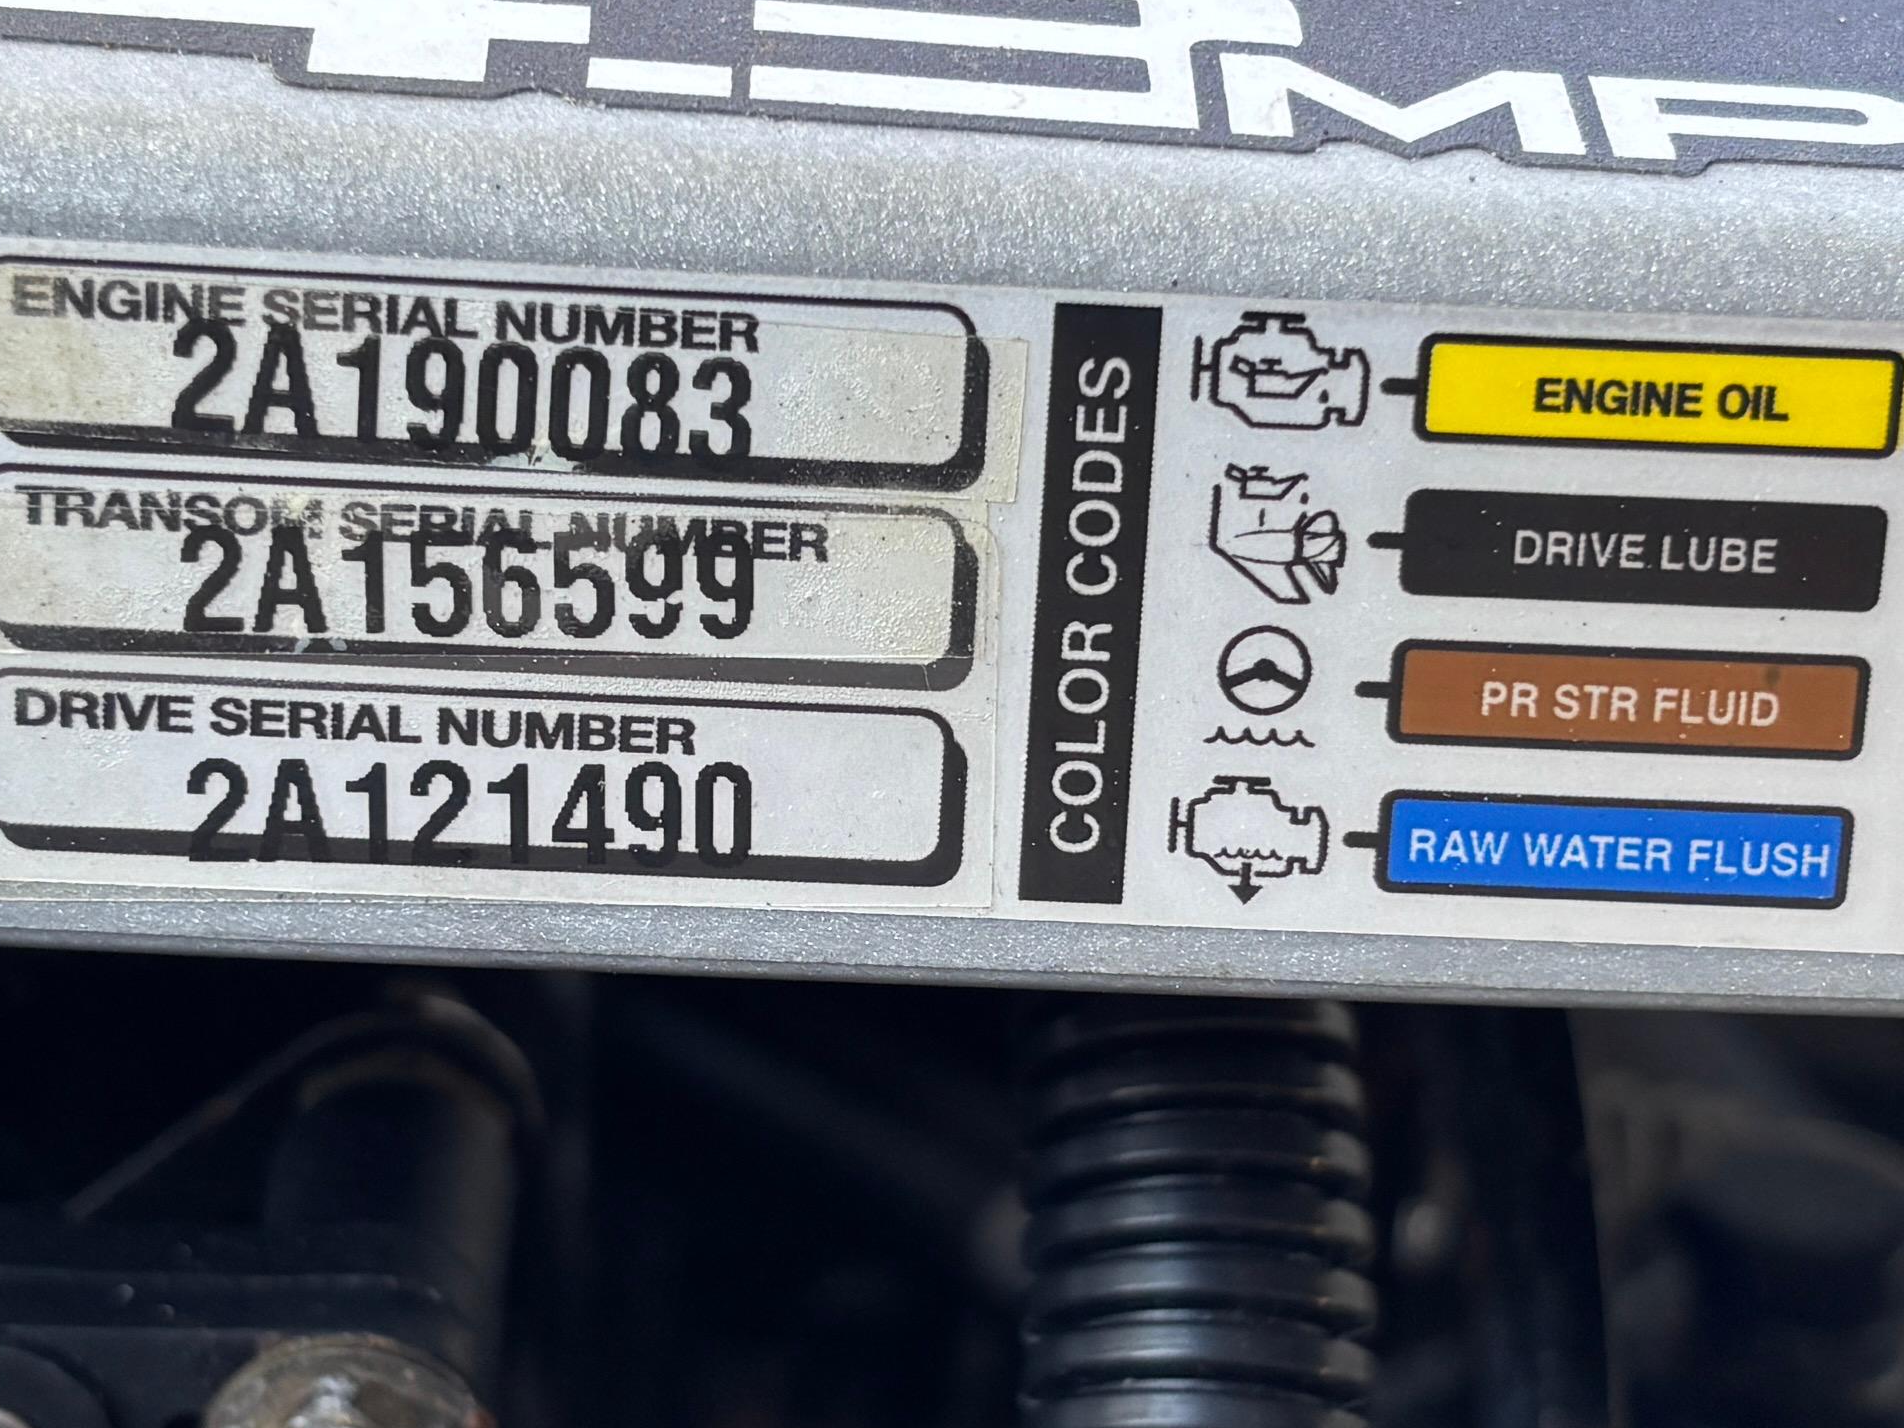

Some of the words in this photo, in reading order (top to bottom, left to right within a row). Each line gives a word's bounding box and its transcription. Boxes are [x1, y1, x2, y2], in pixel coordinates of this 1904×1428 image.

[11, 276, 246, 326] ENGINE
[262, 291, 479, 339] SERIAL
[496, 300, 759, 354] NUMBER
[172, 318, 752, 462] 2A190083
[1534, 378, 1703, 418] ENGINE
[1717, 386, 1789, 422] OIL
[1066, 357, 1132, 596] CODES
[180, 522, 756, 640] 2A156599
[1513, 529, 1645, 569] DRIVE
[1661, 534, 1777, 575] LUBE
[14, 687, 194, 736] DRIVE
[209, 695, 422, 745] SERIAL
[438, 707, 697, 756] NUMBER
[1049, 620, 1113, 854] COLOR
[1480, 682, 1538, 719] PR
[1552, 686, 1638, 722] STR
[1653, 688, 1779, 727] FLUID
[186, 757, 752, 866] 2A121490
[1409, 828, 1509, 865] RAW
[1523, 832, 1671, 872] WATER
[1687, 839, 1830, 878] FLUSH
